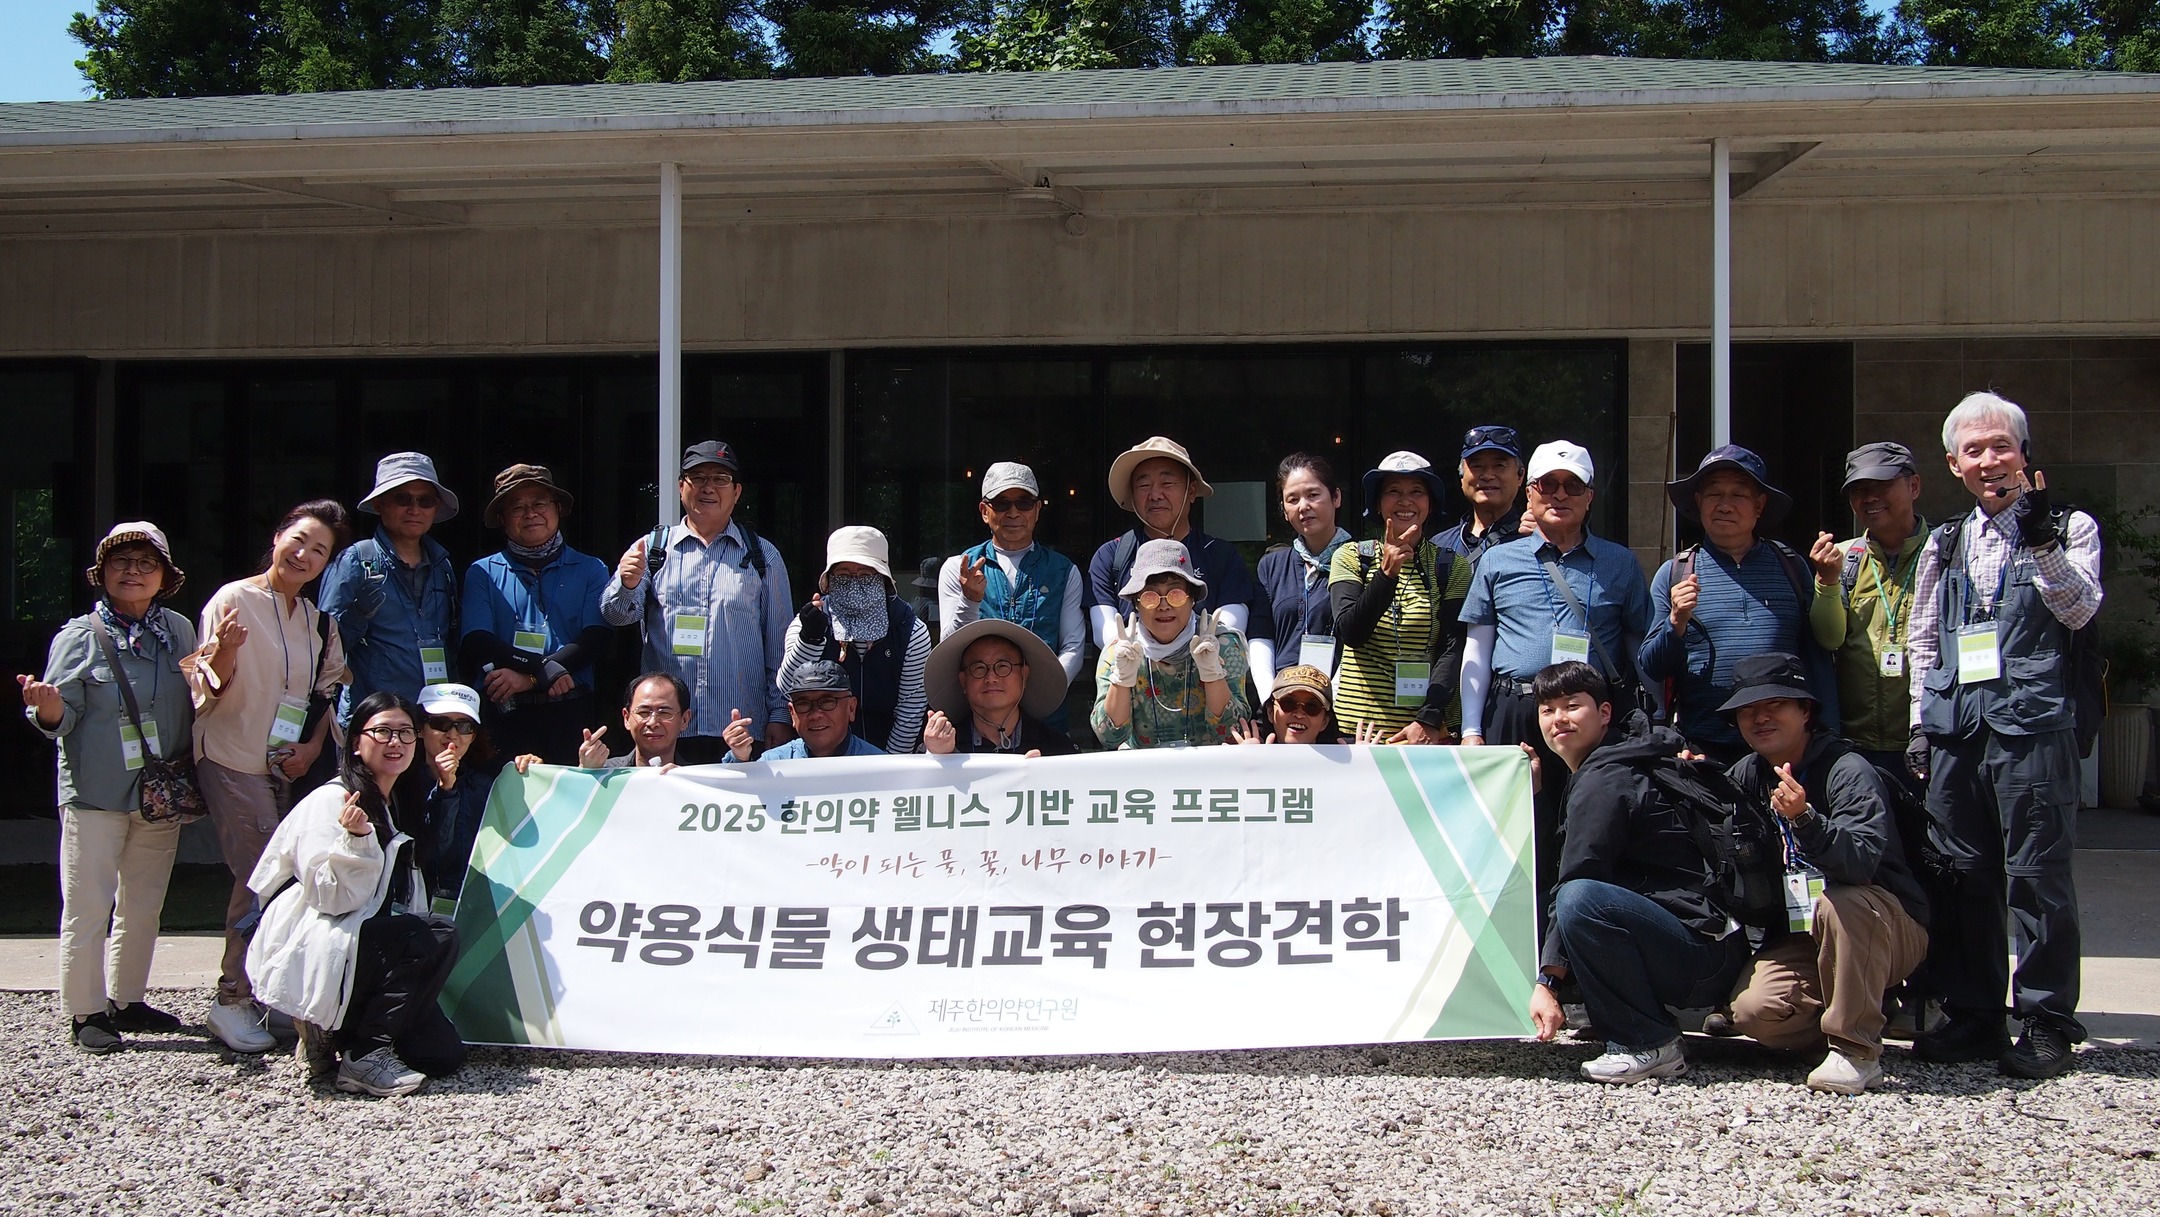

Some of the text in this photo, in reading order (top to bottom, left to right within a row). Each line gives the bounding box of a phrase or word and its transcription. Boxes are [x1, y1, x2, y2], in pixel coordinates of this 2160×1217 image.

[678, 788, 1313, 834] 2025 한의약 웰니스 기반 교육 프로그램
[880, 852, 927, 878] 되는
[1022, 848, 1071, 873] 나무
[577, 897, 1409, 970] 약용식물 생태교육 현장견학
[928, 998, 1078, 1022] 제주한의약연구원
